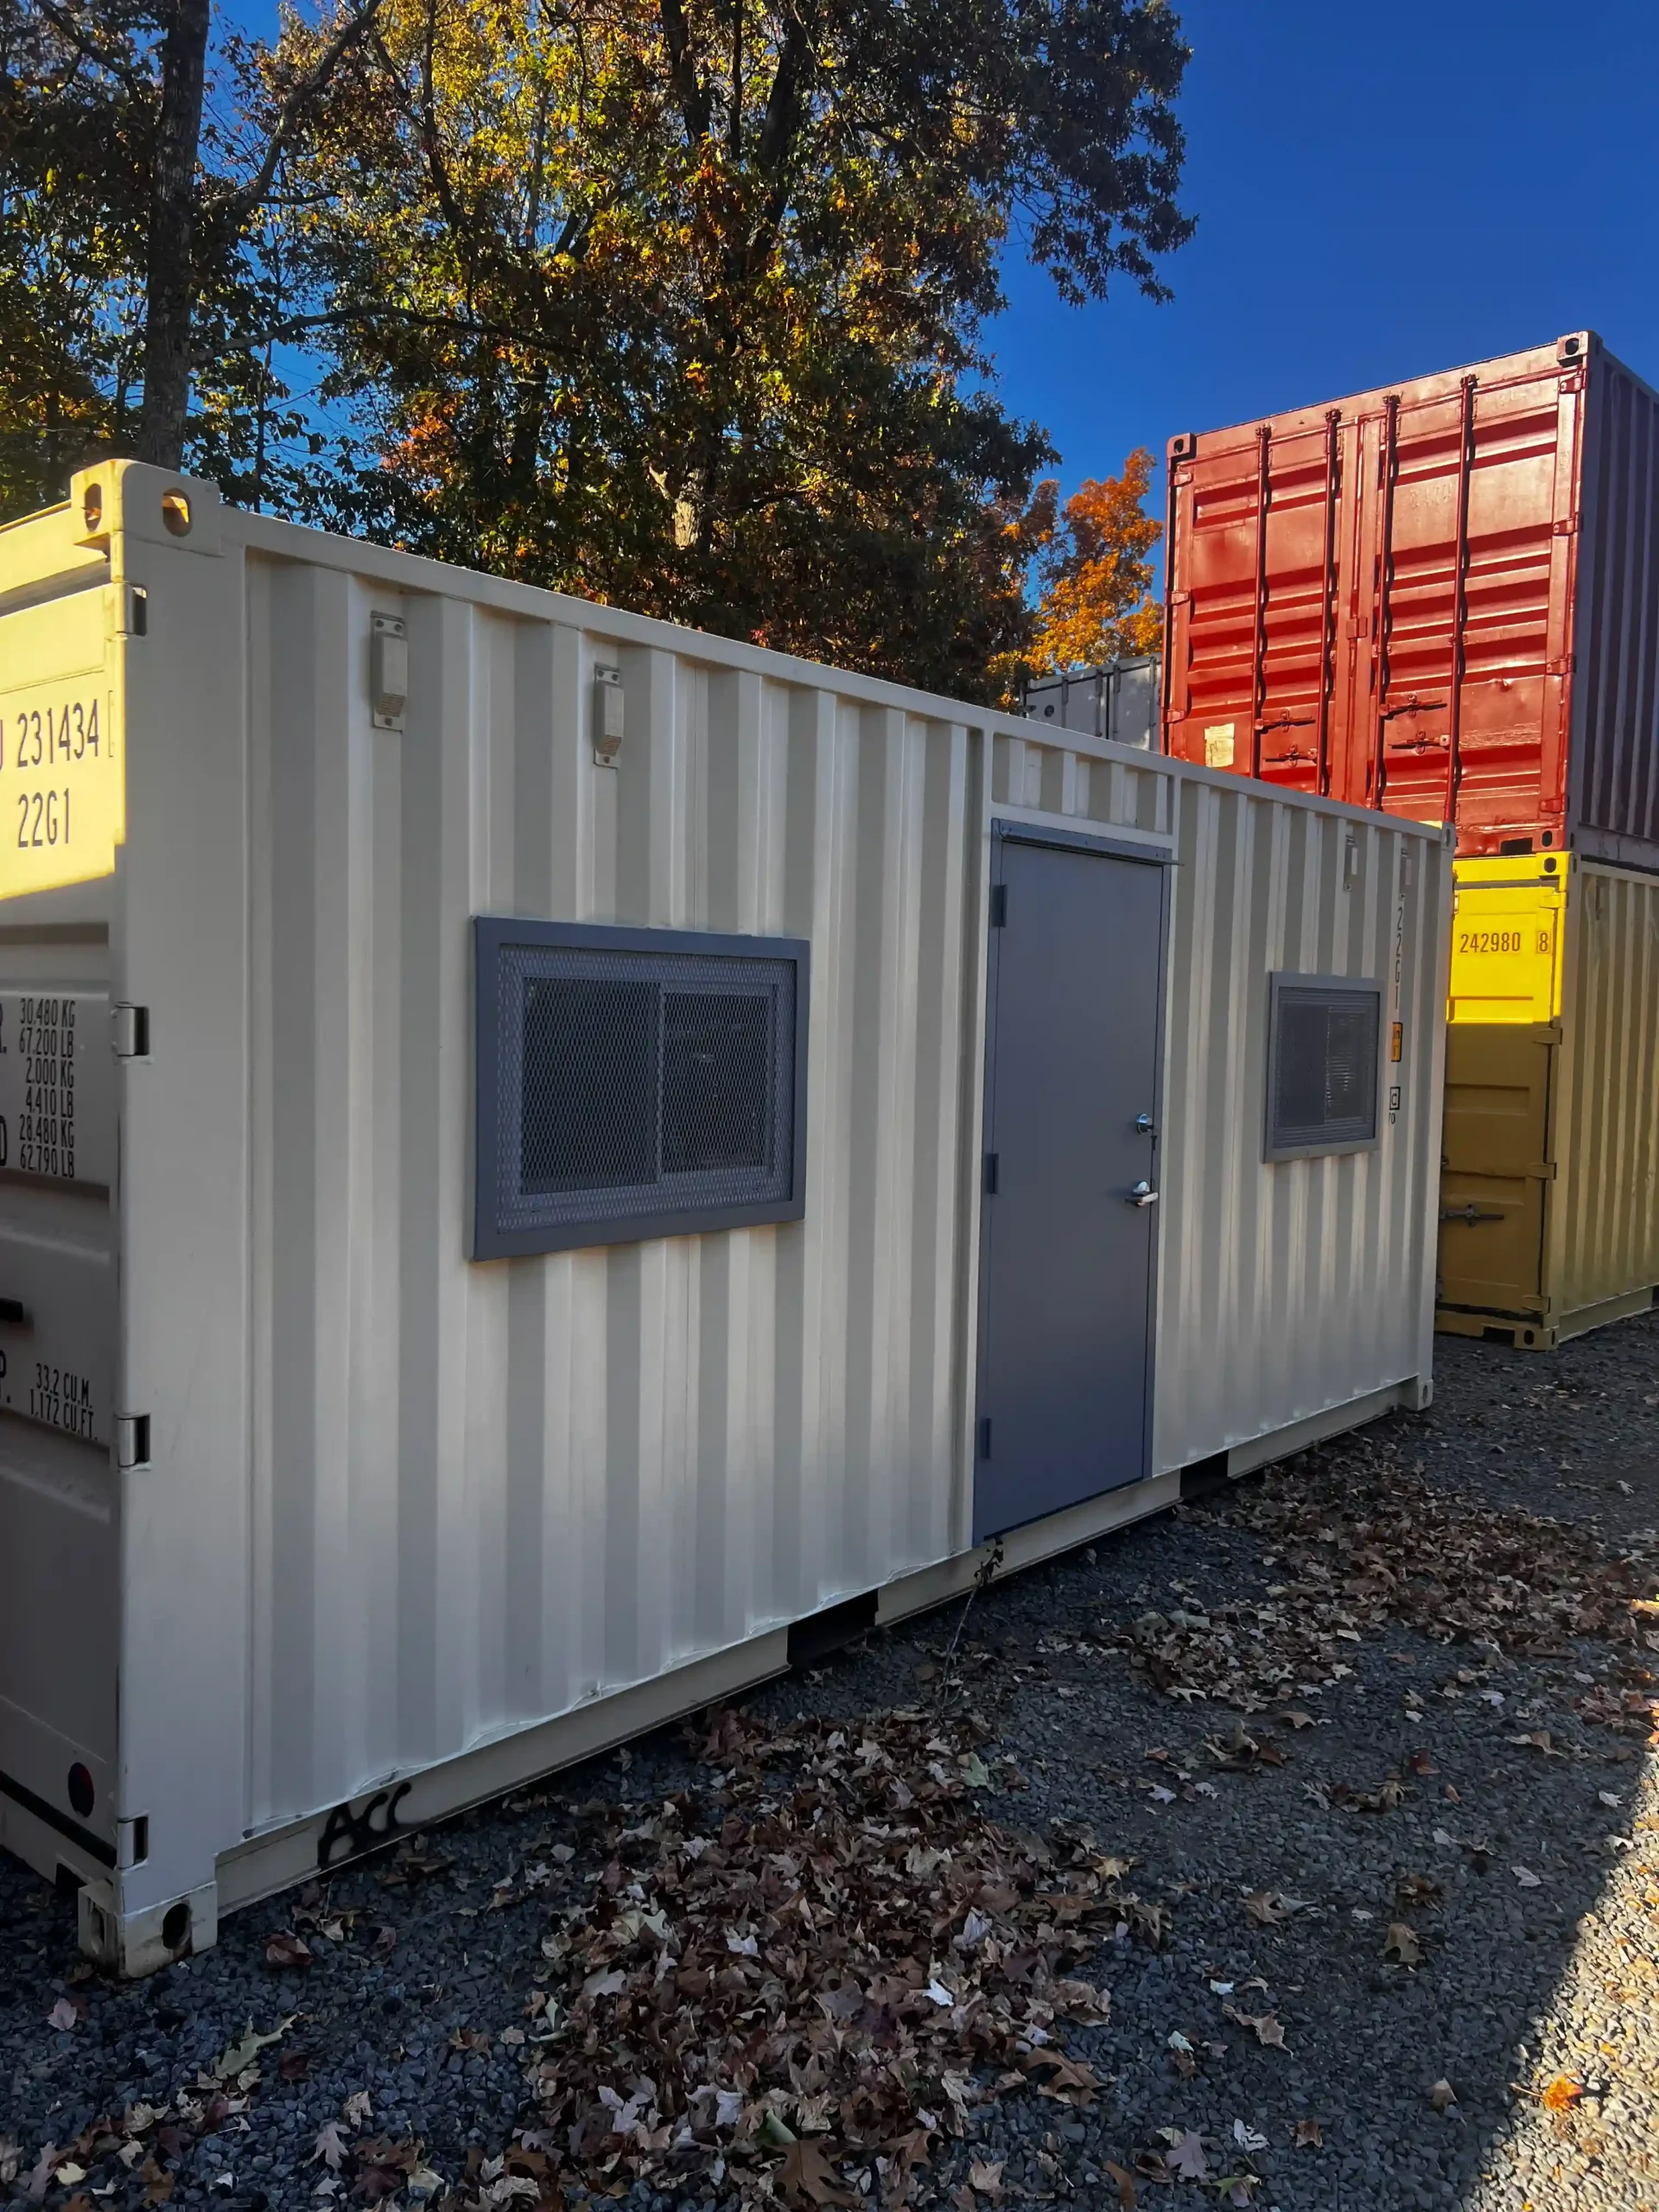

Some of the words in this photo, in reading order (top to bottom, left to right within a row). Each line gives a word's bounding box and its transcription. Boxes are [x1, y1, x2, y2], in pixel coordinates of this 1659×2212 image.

[16, 698, 99, 768] 231434
[17, 787, 70, 849] 22G1
[1459, 931, 1521, 953] 242980
[1539, 932, 1548, 952] 8
[61, 1000, 76, 1027] KG
[60, 1030, 74, 1058] LB
[60, 1059, 74, 1089] KG
[60, 1089, 73, 1119] LB
[60, 1119, 74, 1148] KG
[60, 1148, 74, 1179] LB
[35, 1363, 60, 1396] 33.2
